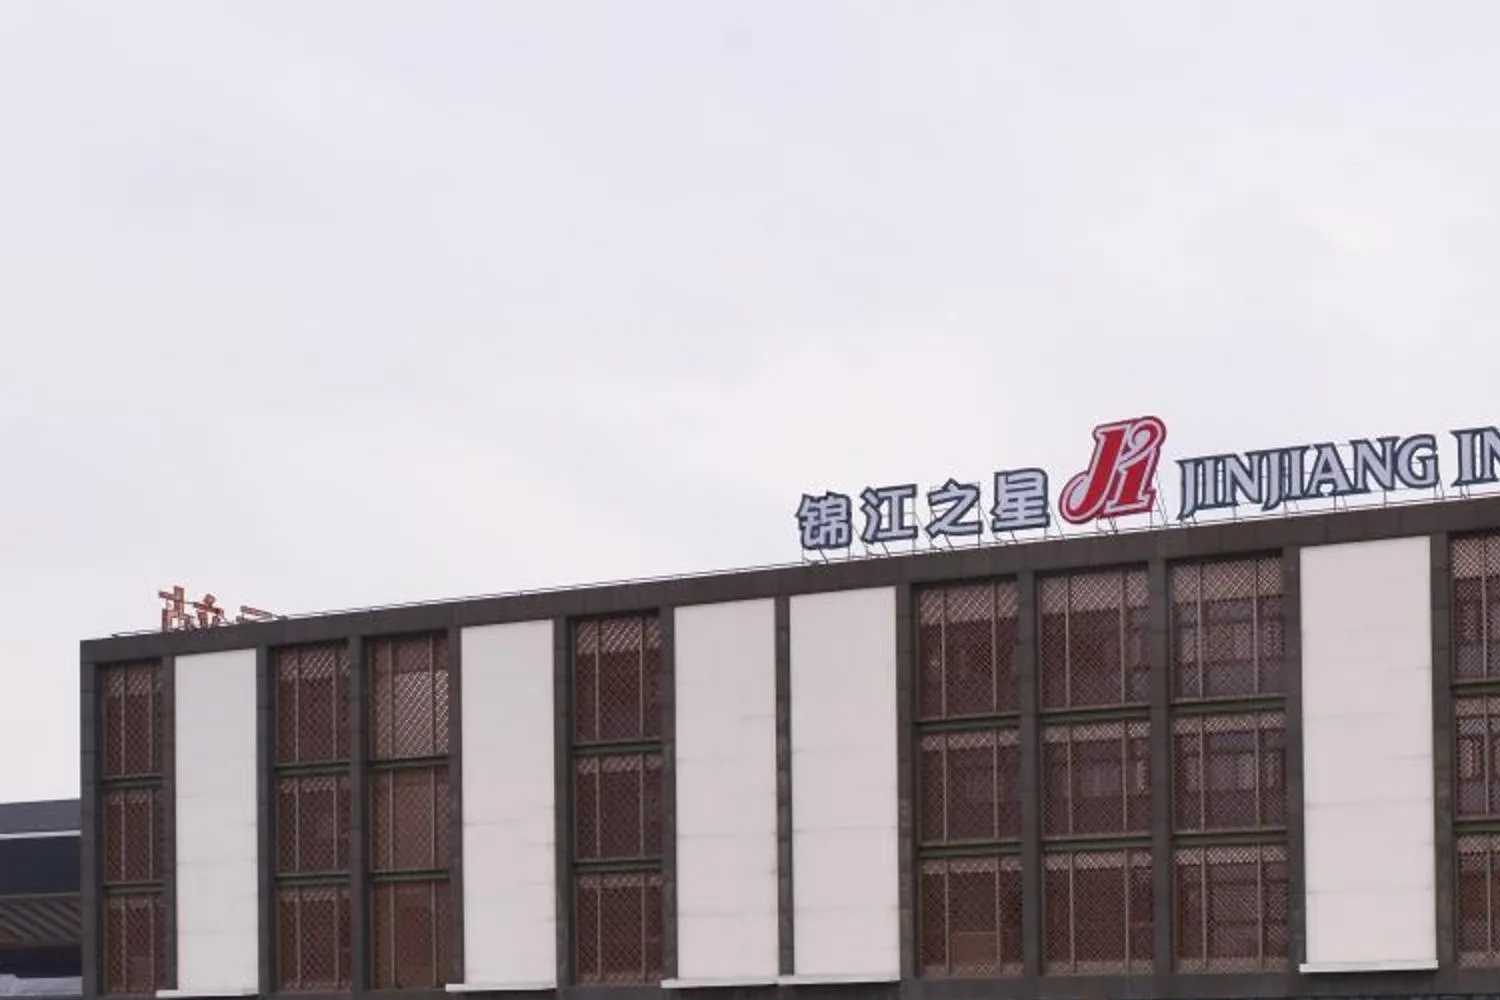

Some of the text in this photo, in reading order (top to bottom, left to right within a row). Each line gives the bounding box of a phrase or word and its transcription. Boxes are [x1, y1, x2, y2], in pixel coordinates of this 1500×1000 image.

[796, 468, 1049, 549] 锦江之星
[1176, 434, 1440, 520] JINJIANG
